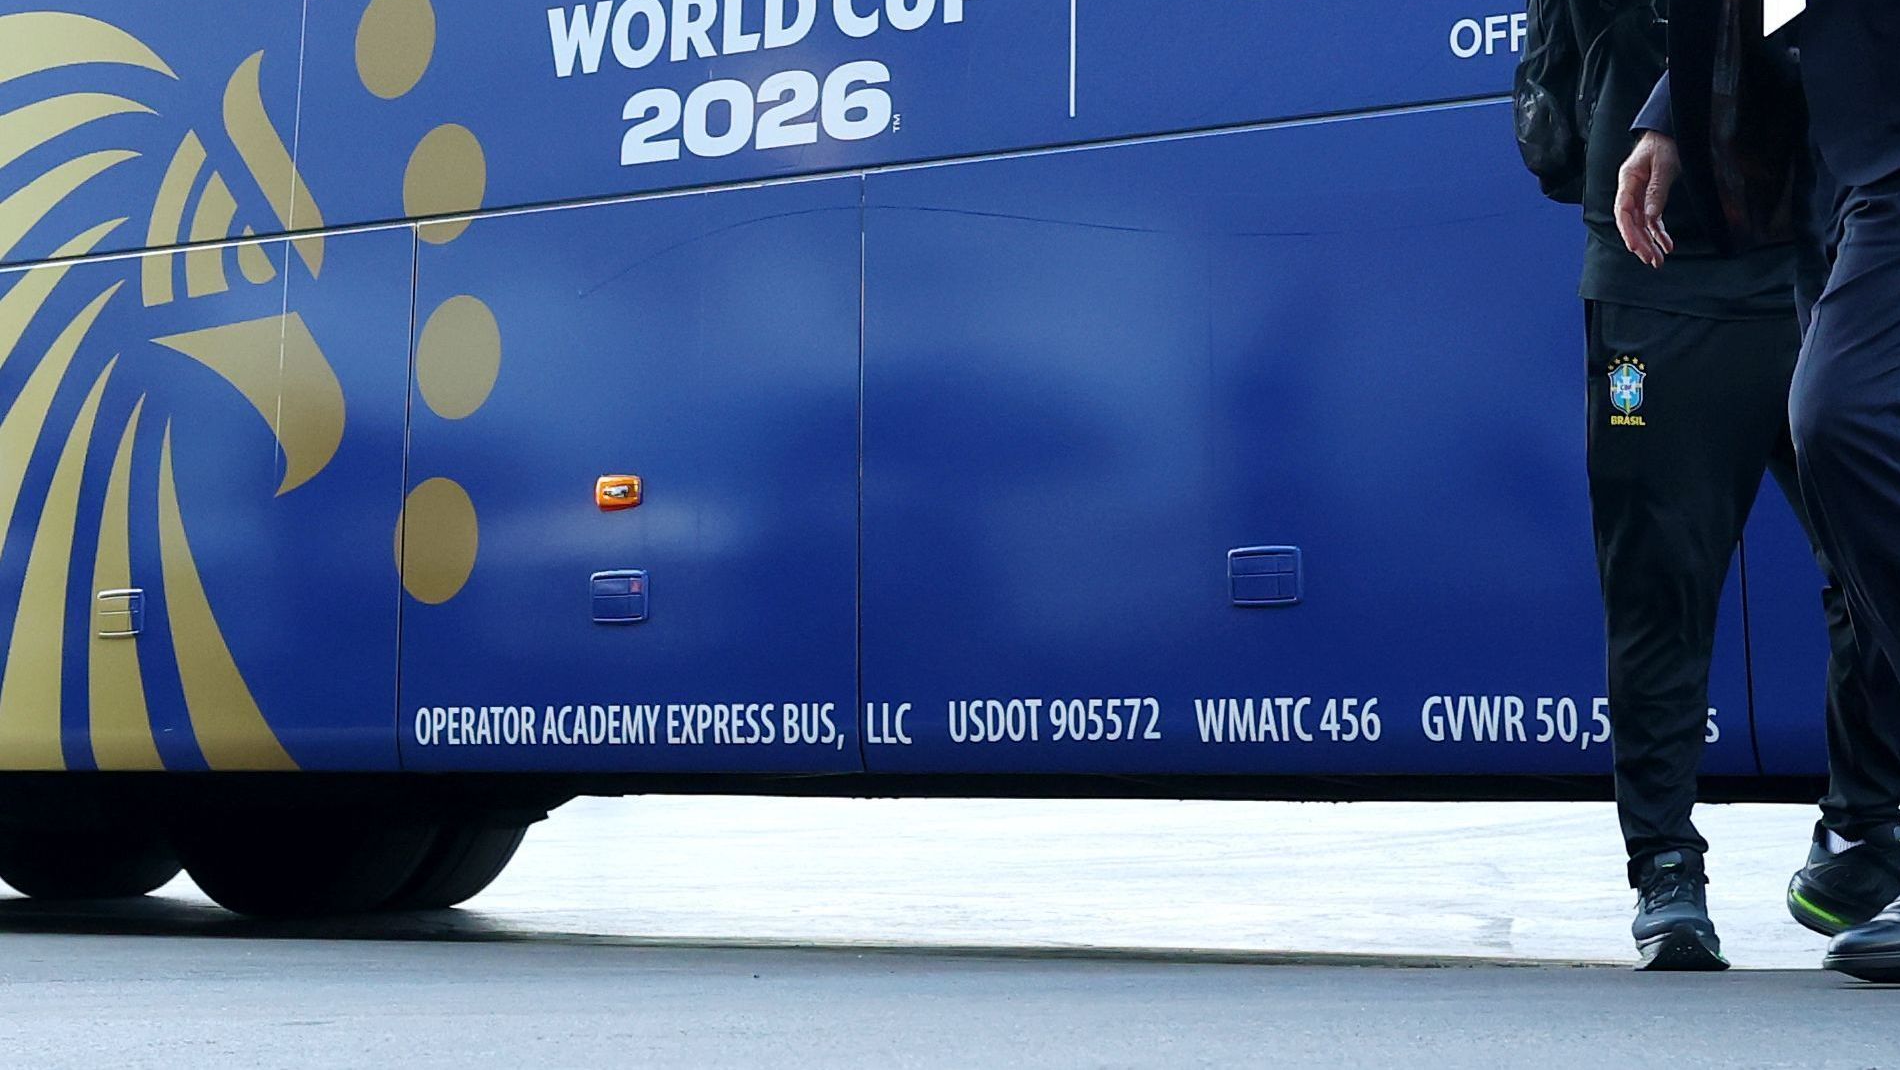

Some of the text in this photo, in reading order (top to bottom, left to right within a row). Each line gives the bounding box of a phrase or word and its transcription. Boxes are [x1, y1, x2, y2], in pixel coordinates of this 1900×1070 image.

[1450, 12, 1527, 58] OFF
[620, 60, 892, 166] 2026
[1610, 415, 1646, 426] BRASIL
[415, 695, 1611, 750] OPERATOR ACADEMY EXPRESS BUS, LLC USDOT 905572 WMATC 456 GVWR 50,5
